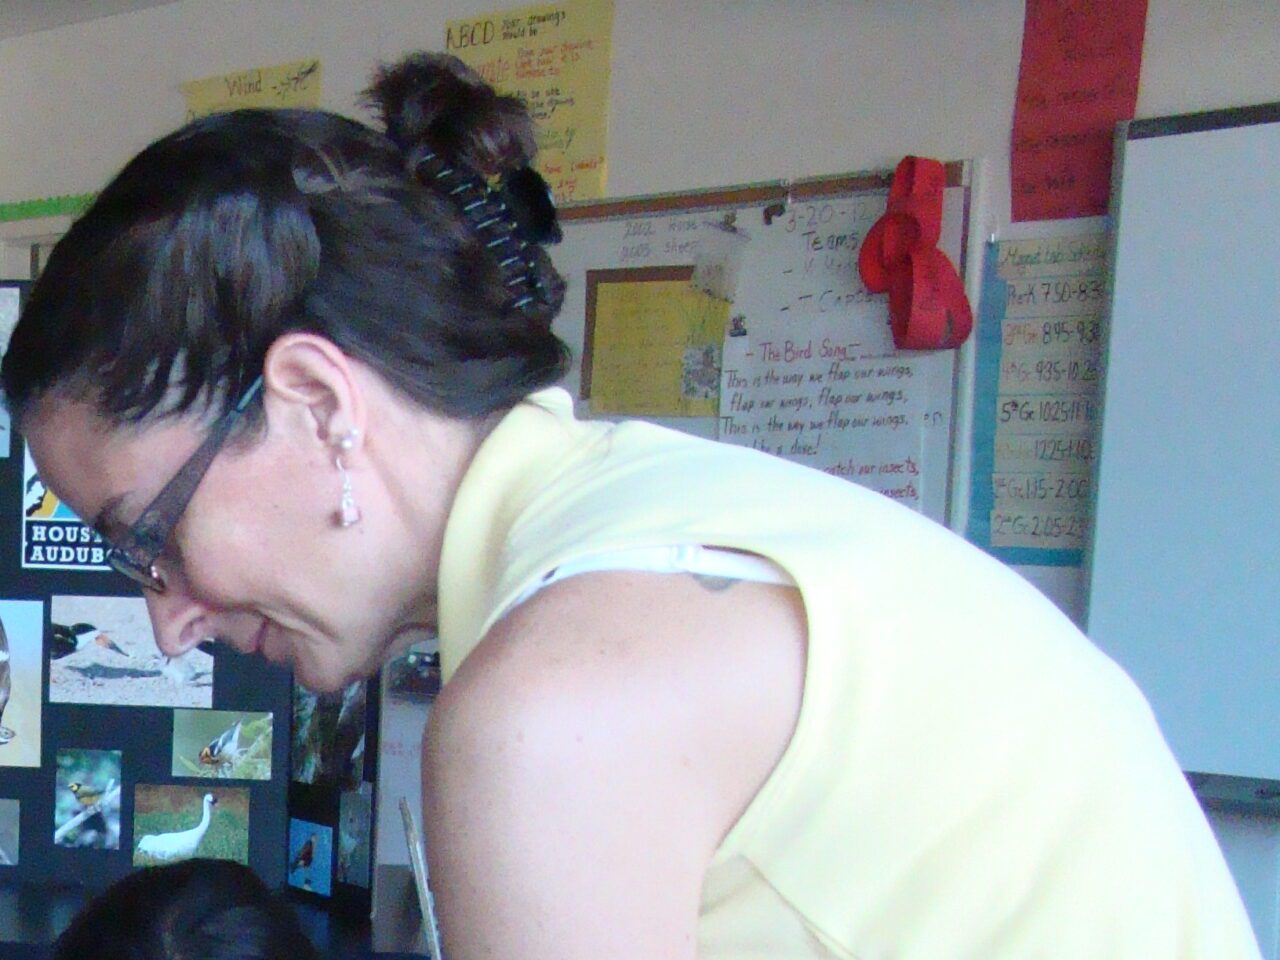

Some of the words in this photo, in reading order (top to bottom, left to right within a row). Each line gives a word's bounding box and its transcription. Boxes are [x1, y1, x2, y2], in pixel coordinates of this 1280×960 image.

[446, 20, 495, 50] ABCD
[224, 70, 262, 97] Wind
[759, 342, 781, 362] The
[784, 340, 812, 363] Bird
[818, 338, 848, 362] Song
[725, 369, 748, 389] This
[765, 369, 780, 385] the
[782, 373, 804, 387] way
[828, 362, 851, 381] flap
[854, 368, 875, 380] our
[877, 365, 914, 379] wings,
[730, 391, 756, 413] flap
[818, 386, 844, 407] flap
[865, 390, 909, 406] wings,
[720, 415, 747, 436] This
[767, 414, 784, 432] the
[787, 420, 806, 435] way
[827, 410, 850, 431] flap
[790, 433, 823, 456] dove!
[858, 464, 877, 477] our
[878, 456, 920, 477] insects,
